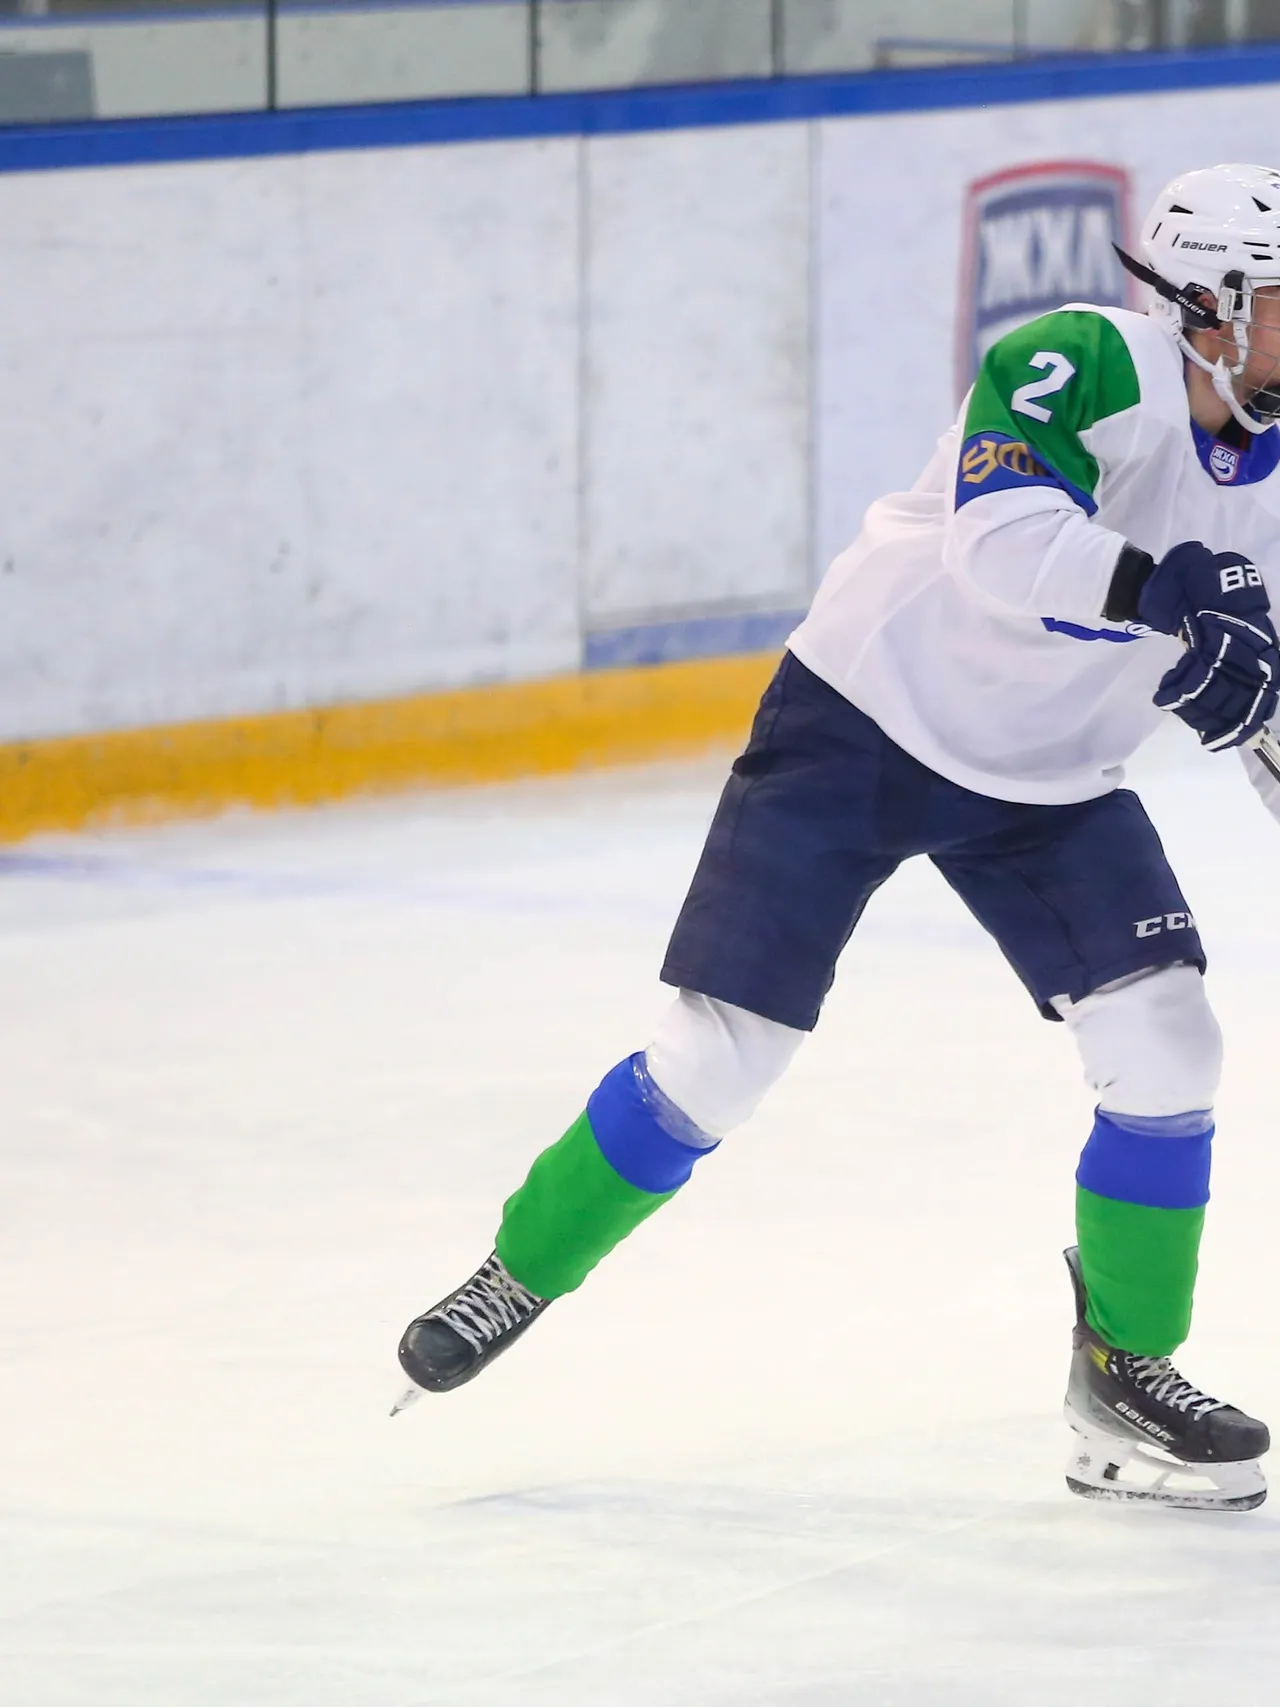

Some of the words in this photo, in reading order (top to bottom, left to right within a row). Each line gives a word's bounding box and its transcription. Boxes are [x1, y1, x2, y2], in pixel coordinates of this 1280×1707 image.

[1180, 240, 1228, 253] BAUER
[1010, 351, 1077, 424] 2
[1115, 1401, 1176, 1442] BAUER
